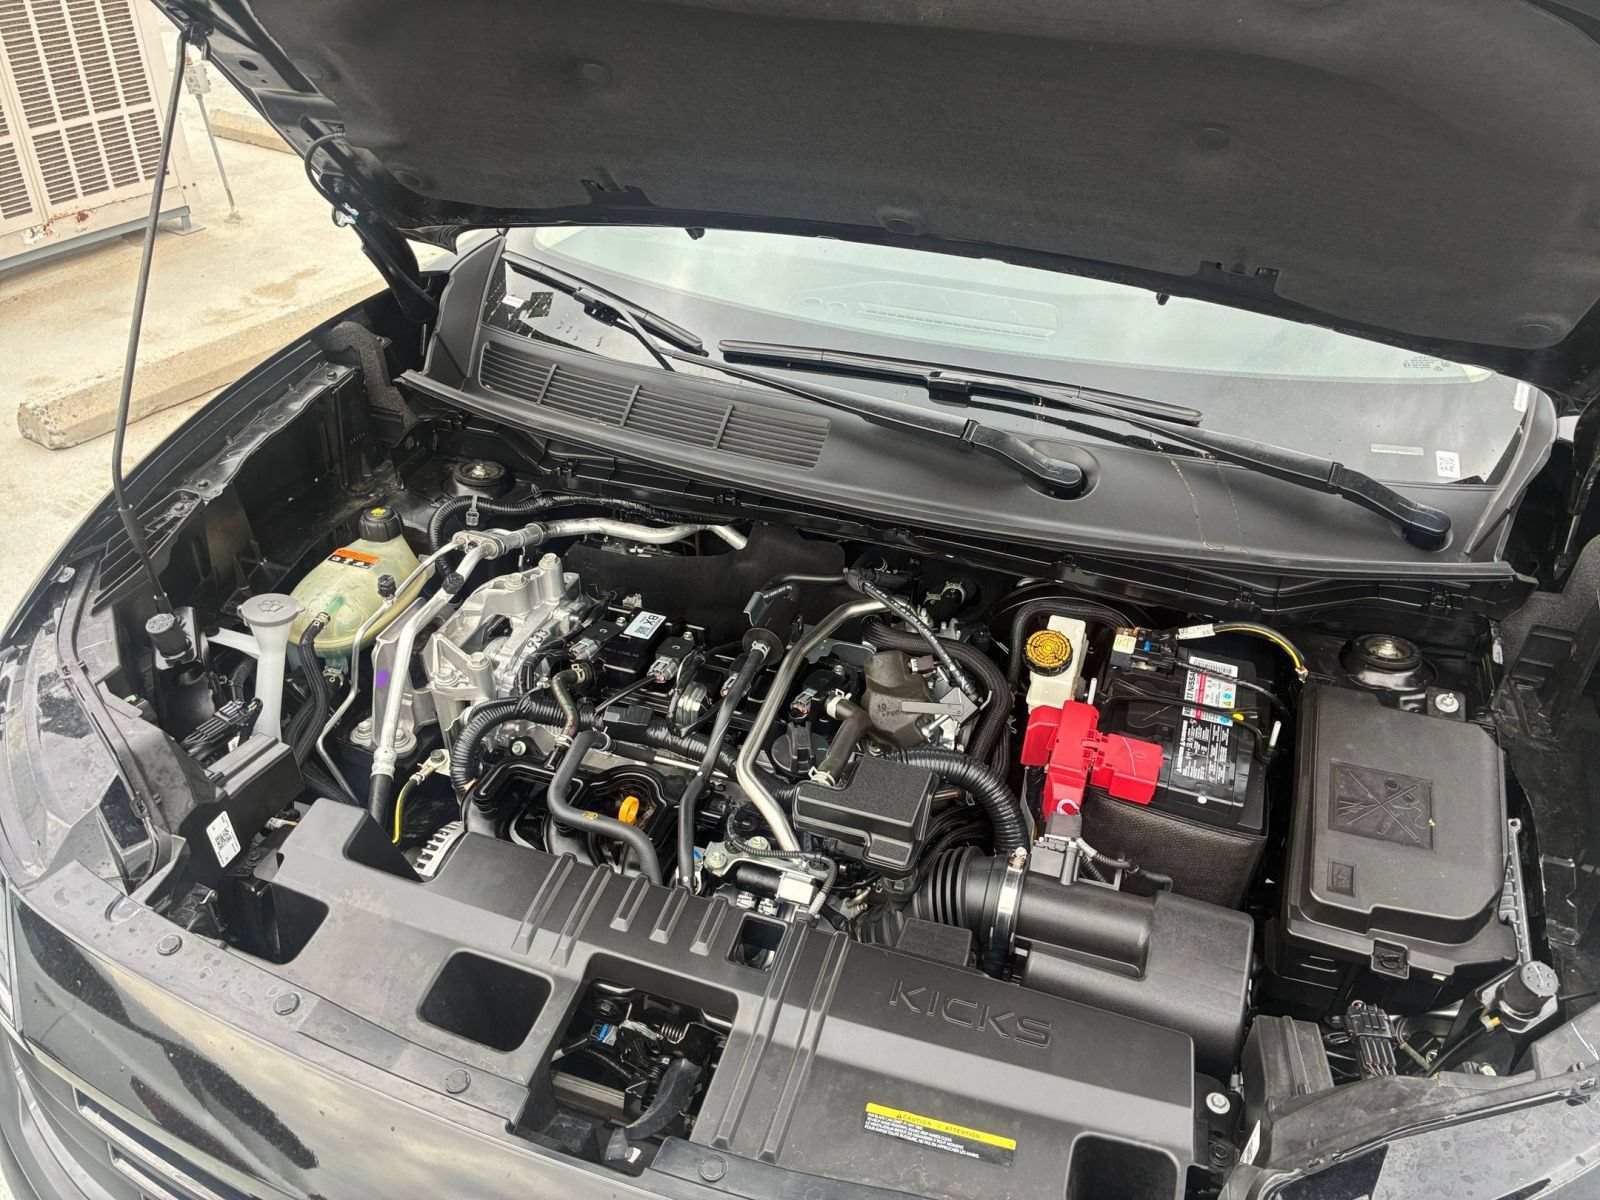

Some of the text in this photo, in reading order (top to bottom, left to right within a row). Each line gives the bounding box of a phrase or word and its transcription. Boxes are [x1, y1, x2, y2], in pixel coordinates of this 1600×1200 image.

[889, 979, 1052, 1049] KICKS
[902, 1114, 932, 1127] CAUTION
[944, 1125, 981, 1140] ATTENTION
